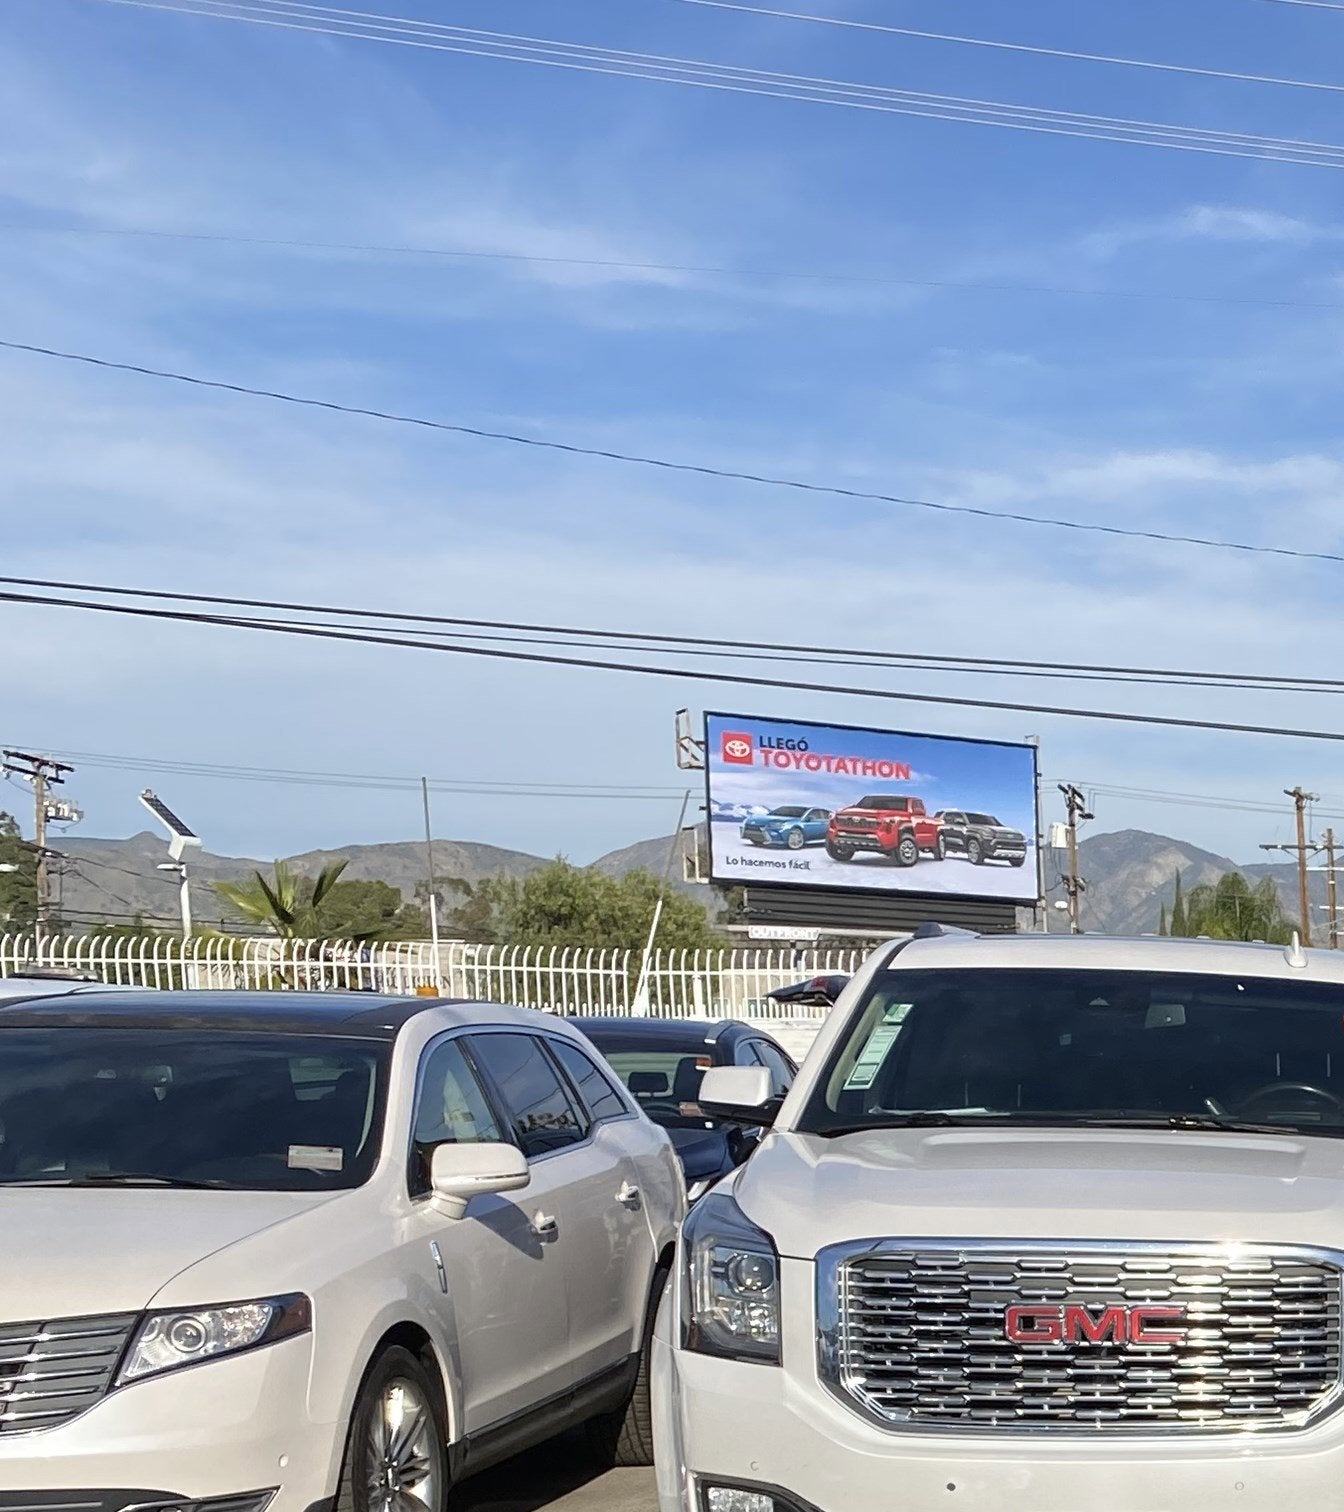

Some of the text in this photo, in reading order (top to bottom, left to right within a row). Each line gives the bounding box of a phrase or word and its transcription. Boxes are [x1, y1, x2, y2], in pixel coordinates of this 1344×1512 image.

[759, 735, 809, 751] LLEGÓ
[760, 750, 911, 780] TOYOTATHON
[725, 856, 739, 866] Lo
[740, 857, 787, 869] hacemos
[1005, 1304, 1187, 1346] GMC
